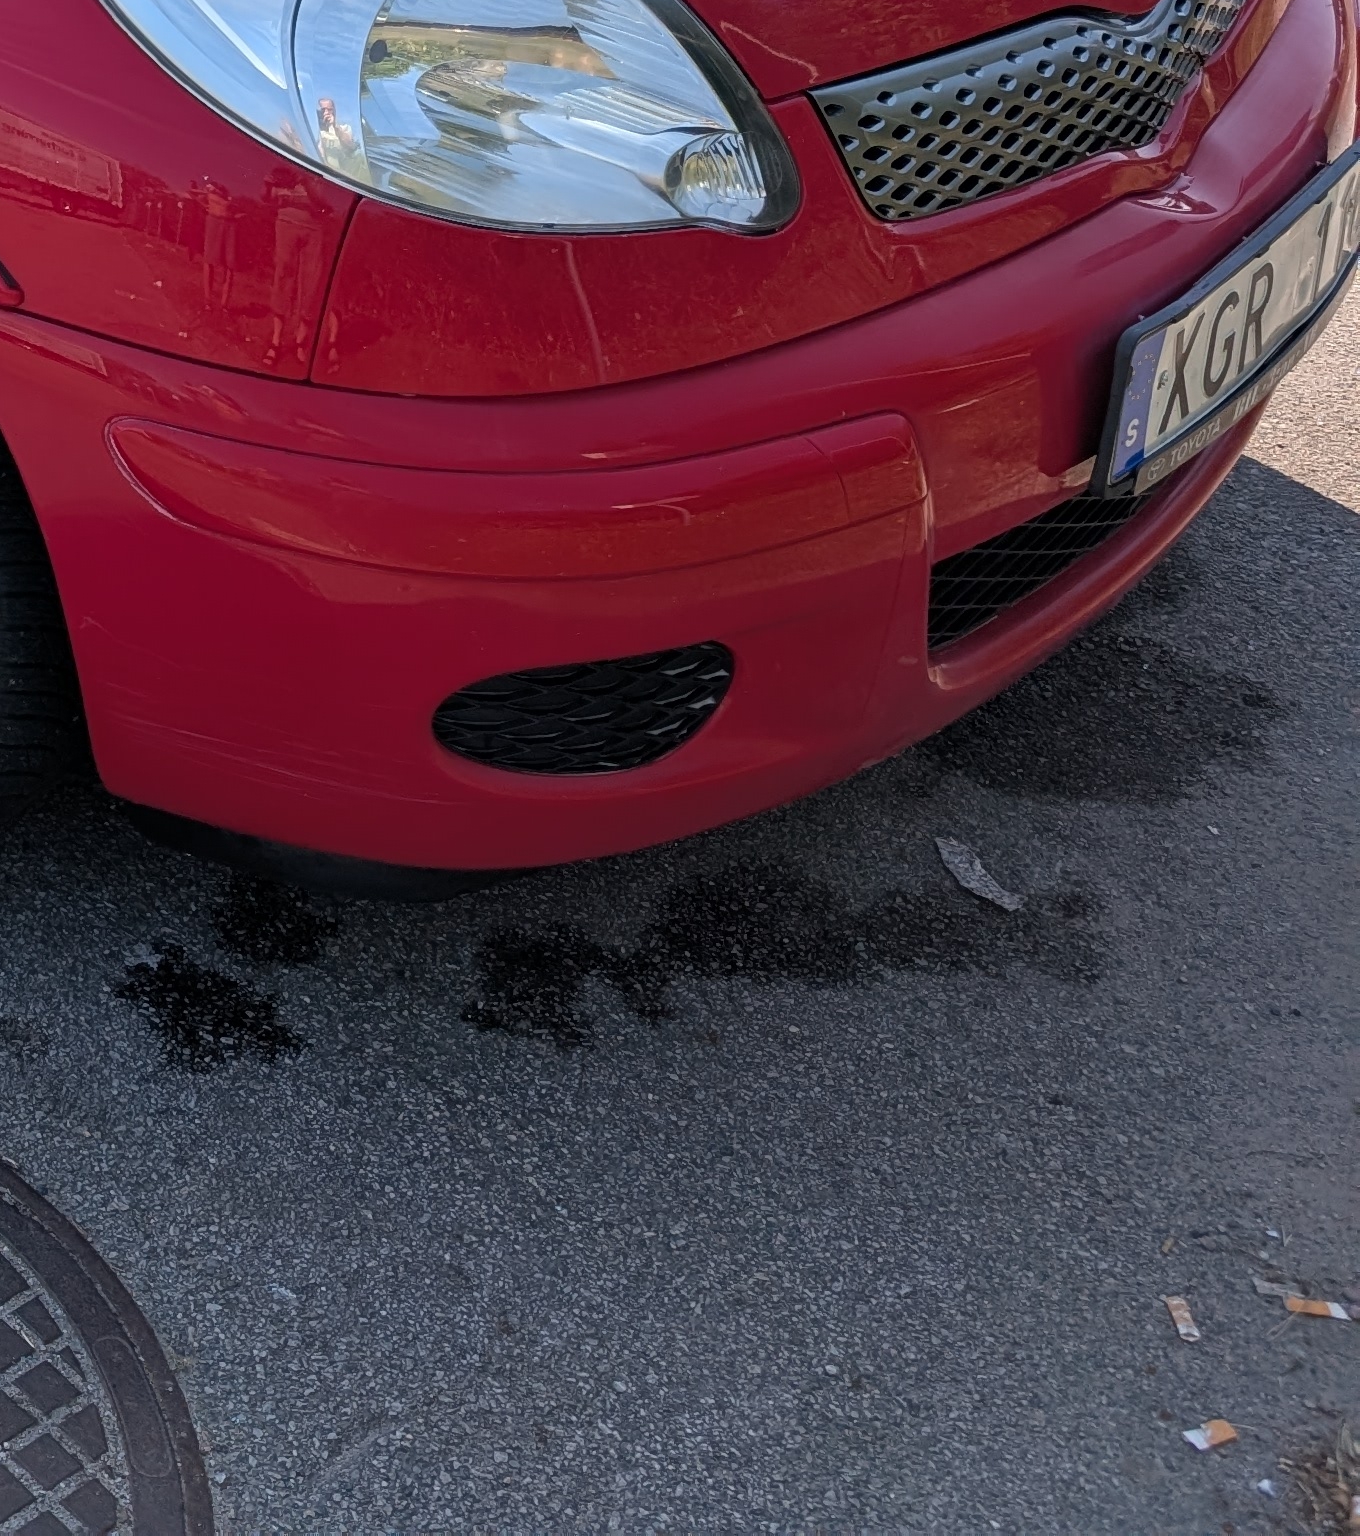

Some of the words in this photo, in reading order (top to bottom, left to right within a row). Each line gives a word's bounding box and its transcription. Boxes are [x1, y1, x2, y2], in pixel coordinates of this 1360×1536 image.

[1157, 261, 1275, 437] XGR
[1124, 418, 1139, 448] S
[1169, 416, 1222, 467] TOYOTA
